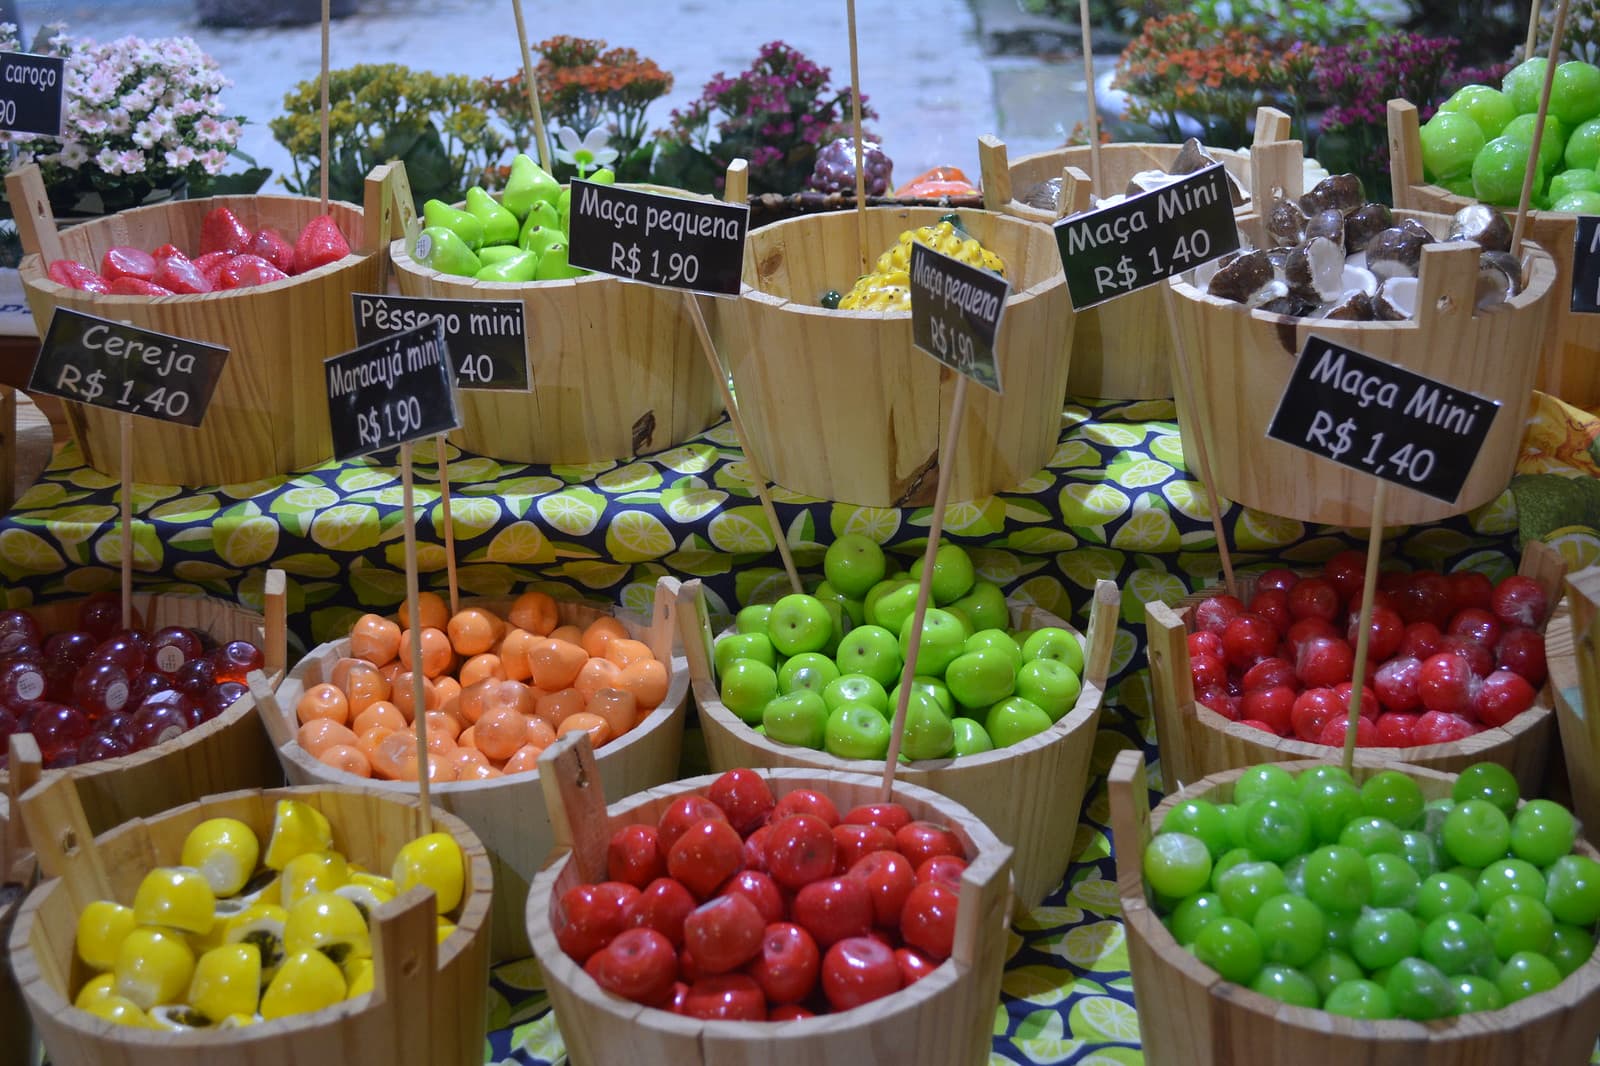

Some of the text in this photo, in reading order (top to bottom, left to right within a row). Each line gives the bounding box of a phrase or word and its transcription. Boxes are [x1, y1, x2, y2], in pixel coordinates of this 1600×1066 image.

[5, 64, 56, 92] caroço
[579, 187, 739, 241] Maça pequena
[1068, 174, 1218, 256] Maça Mini
[611, 242, 699, 284] R$ 1,90
[913, 250, 1000, 323] Maça pequena
[1094, 229, 1210, 294] R$ 1,40
[470, 307, 521, 336] mini
[930, 316, 975, 371] R$ 1,90
[82, 325, 196, 377] Cereja
[329, 330, 440, 399] Maracujá mini
[56, 364, 190, 417] R$ 1,40
[1308, 349, 1480, 436] Maça Mini
[357, 396, 422, 448] R$ 1,90
[1305, 410, 1435, 483] R$ 1,40
